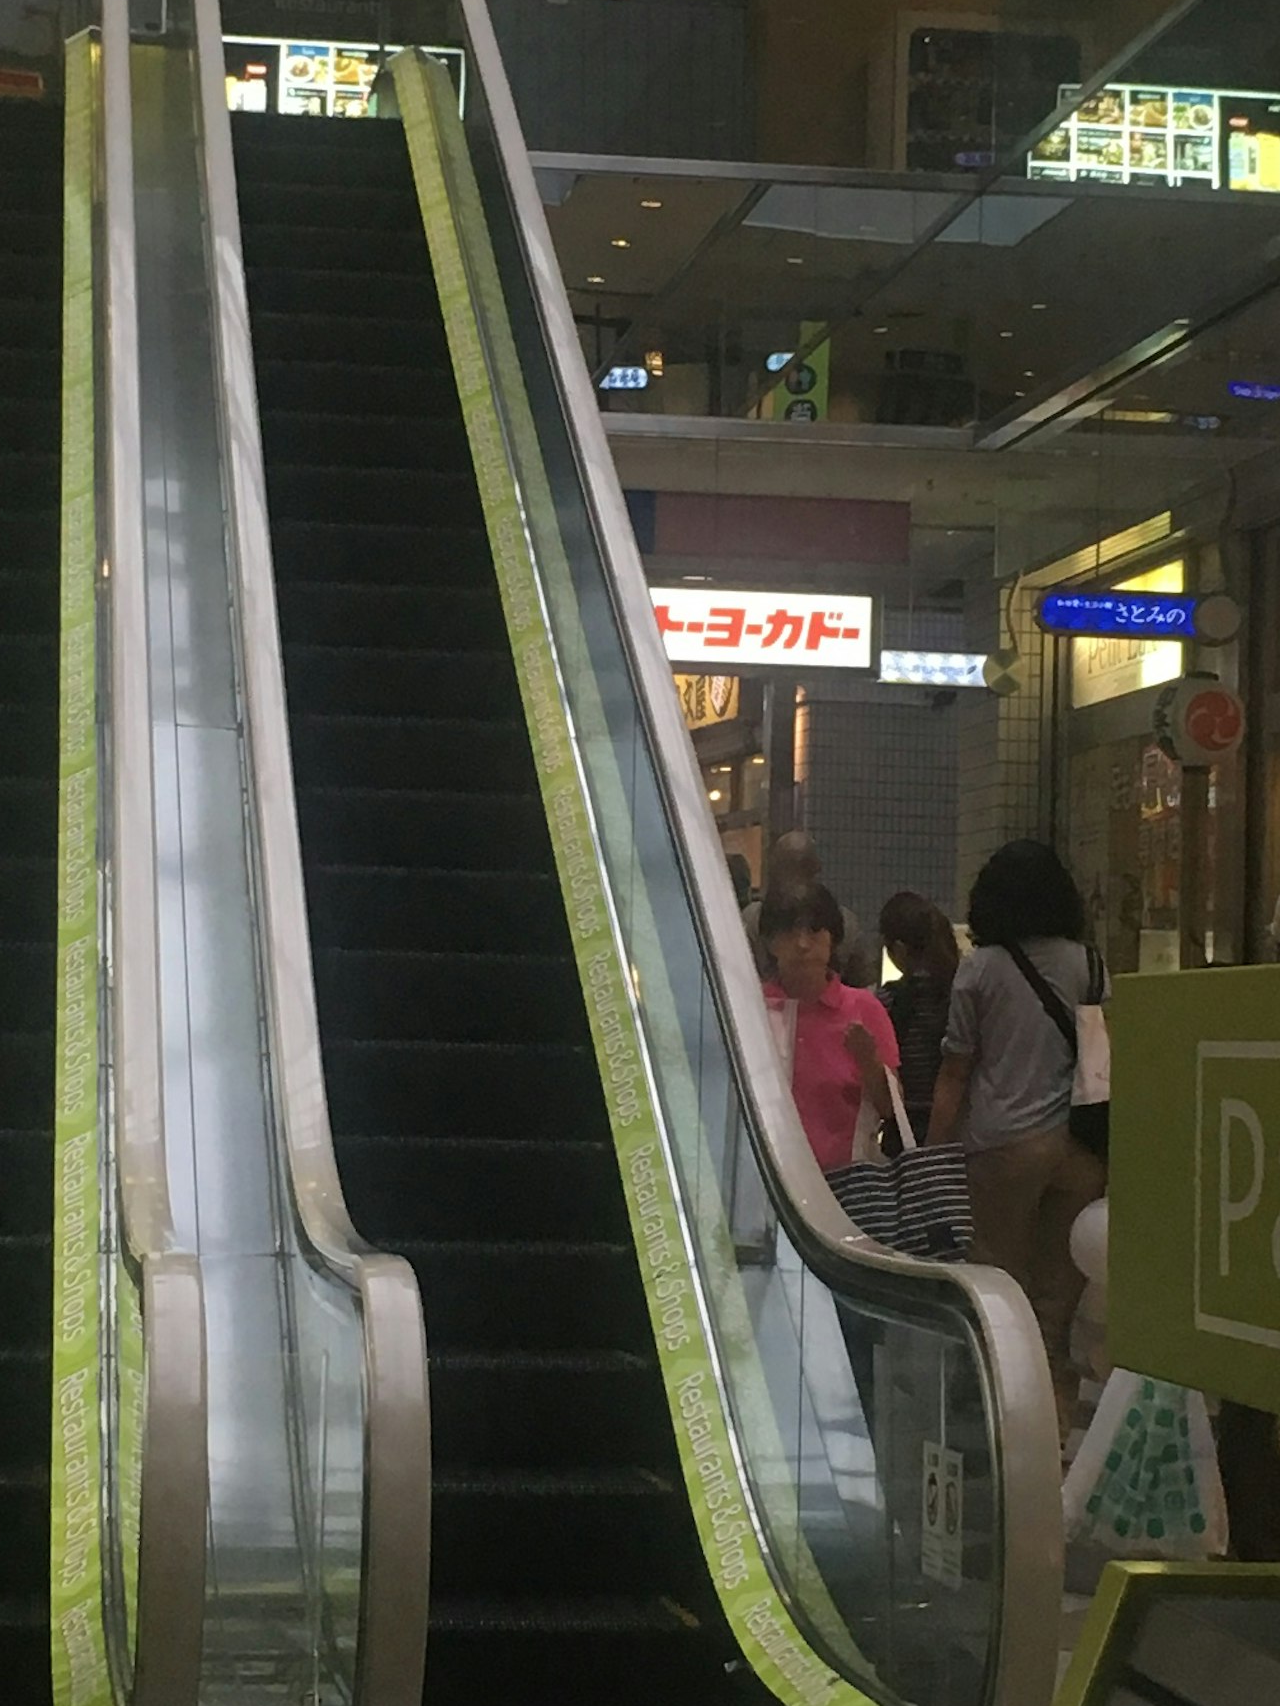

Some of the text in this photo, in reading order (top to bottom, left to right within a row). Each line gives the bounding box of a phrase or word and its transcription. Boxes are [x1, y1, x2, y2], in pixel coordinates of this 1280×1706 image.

[1116, 603, 1185, 624] さとみの
[589, 949, 626, 1055] Restaurants
[611, 1064, 642, 1127] Shops
[627, 1144, 672, 1266] Restaurants
[656, 1279, 691, 1353] Shops
[59, 1367, 90, 1500] Restaurants
[675, 1370, 732, 1509] Restaurants
[714, 1519, 750, 1590] Shops
[63, 1517, 97, 1588] Shops
